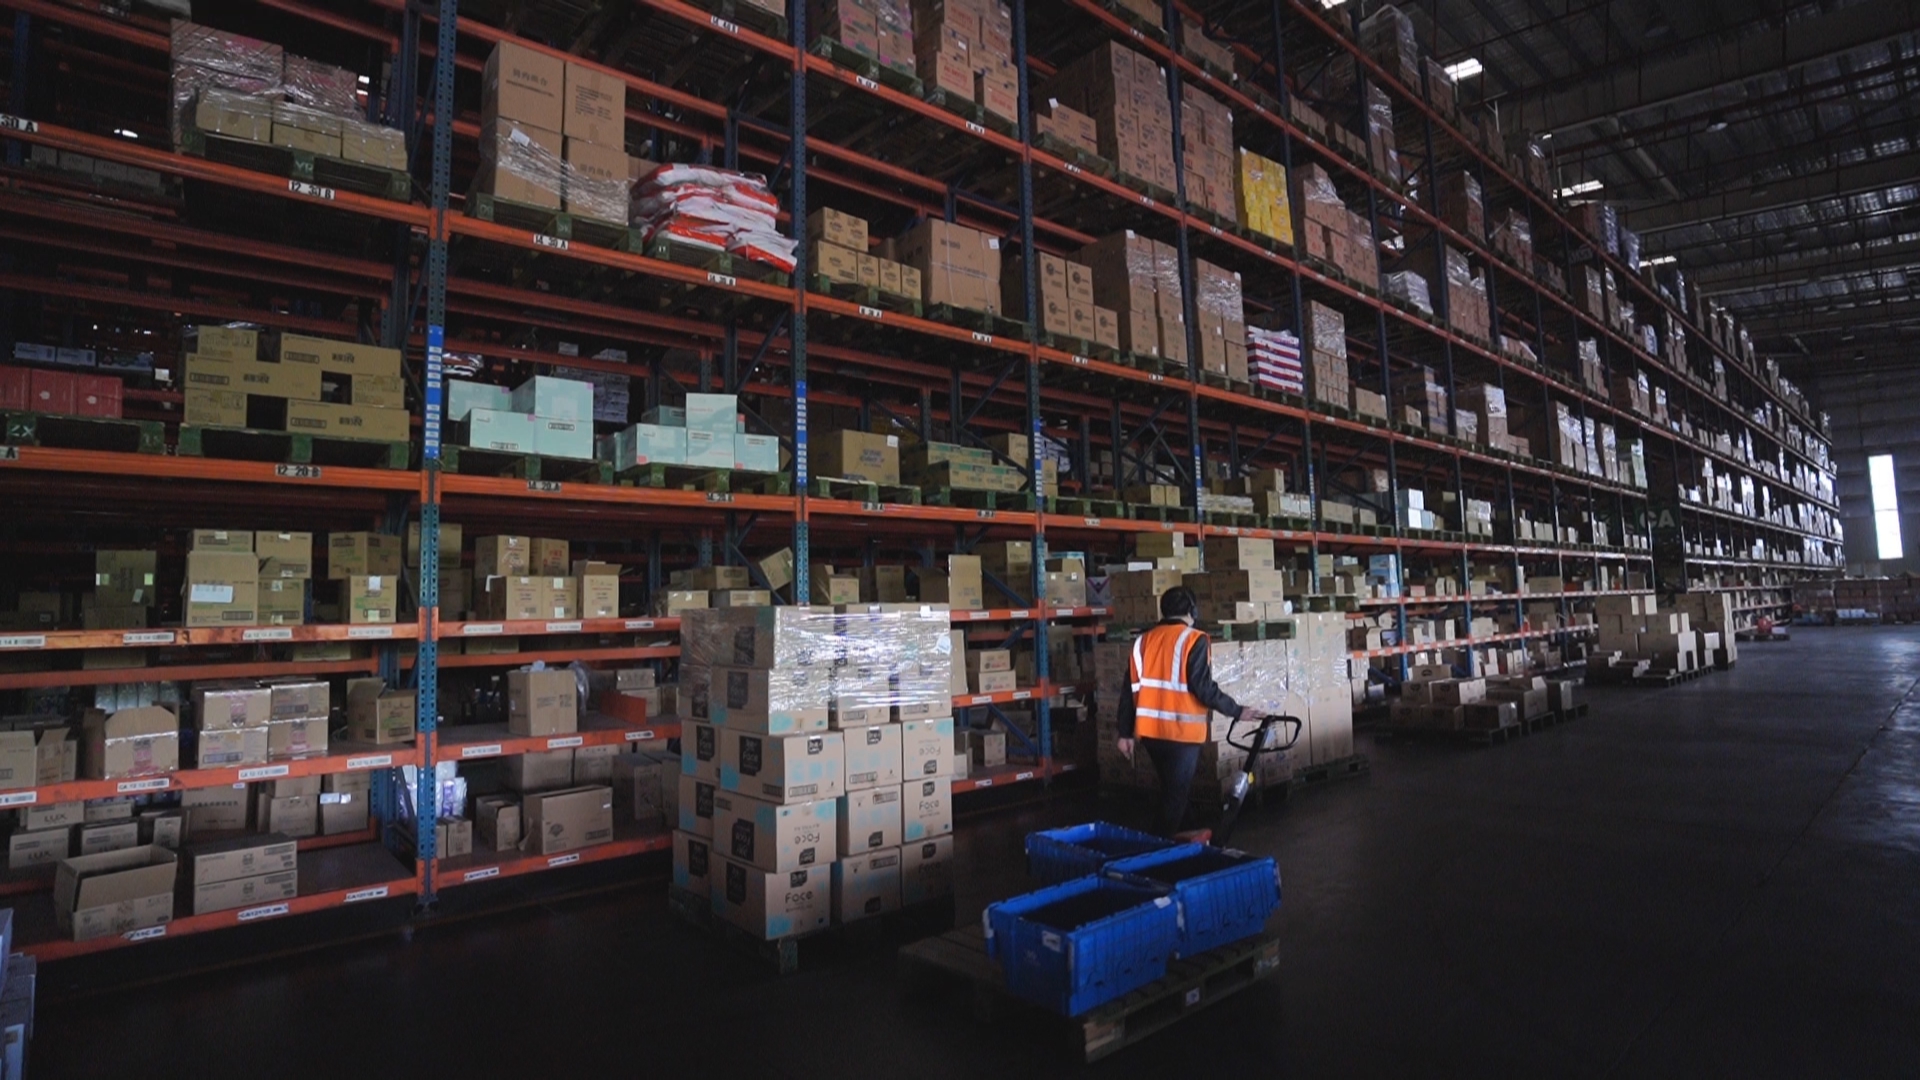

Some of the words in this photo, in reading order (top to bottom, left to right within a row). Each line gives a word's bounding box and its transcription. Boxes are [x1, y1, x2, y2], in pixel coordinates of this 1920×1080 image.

[25, 121, 34, 133] A
[290, 180, 301, 192] 12
[534, 234, 543, 245] 14
[560, 240, 567, 250] A
[6, 446, 16, 459] A
[277, 464, 288, 475] 12
[295, 466, 309, 476] 20
[553, 482, 561, 492] A
[1639, 508, 1675, 529] CA
[44, 814, 68, 823] LUX
[28, 851, 52, 860] LUX
